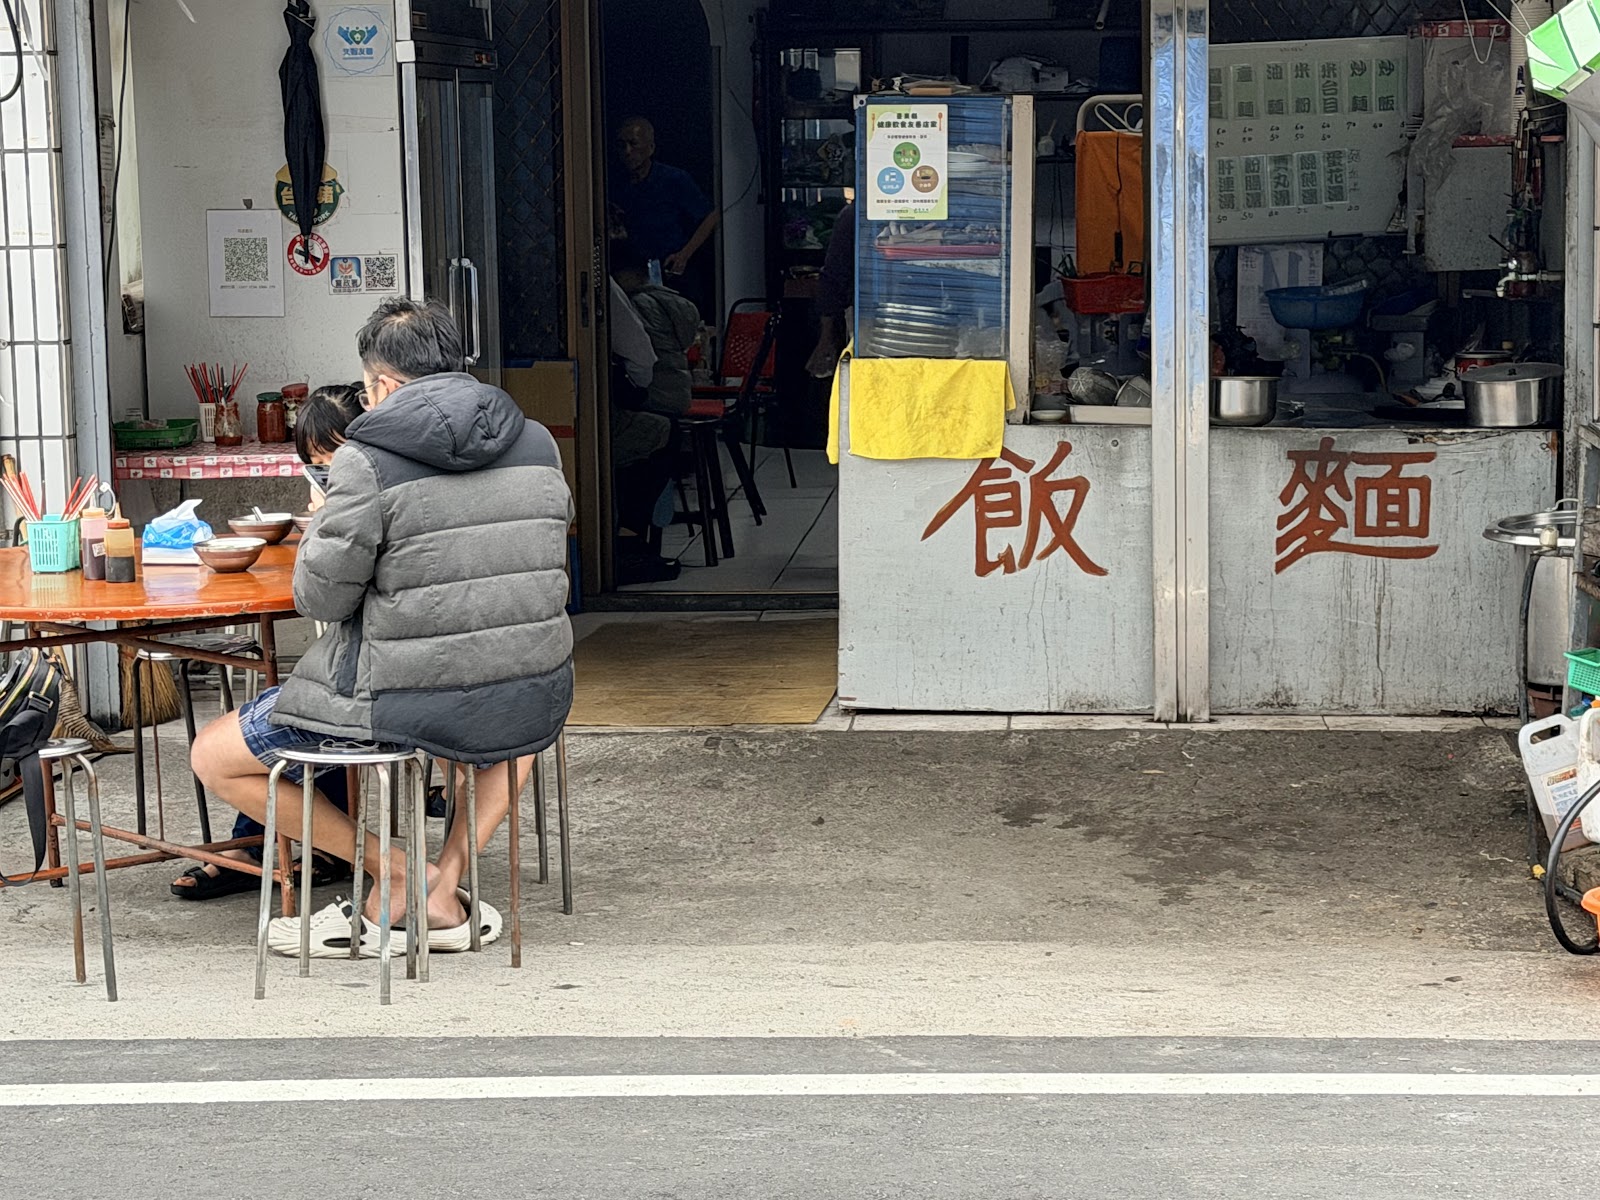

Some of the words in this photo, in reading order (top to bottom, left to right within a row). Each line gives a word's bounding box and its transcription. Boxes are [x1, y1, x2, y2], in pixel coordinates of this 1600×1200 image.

[1321, 62, 1338, 113] 米台目
[280, 186, 334, 205] 台豬
[313, 210, 331, 223] PORK
[1216, 214, 1228, 223] 50
[1241, 211, 1254, 221] 50
[920, 440, 1109, 577] 飯
[1275, 436, 1440, 574] 麵
